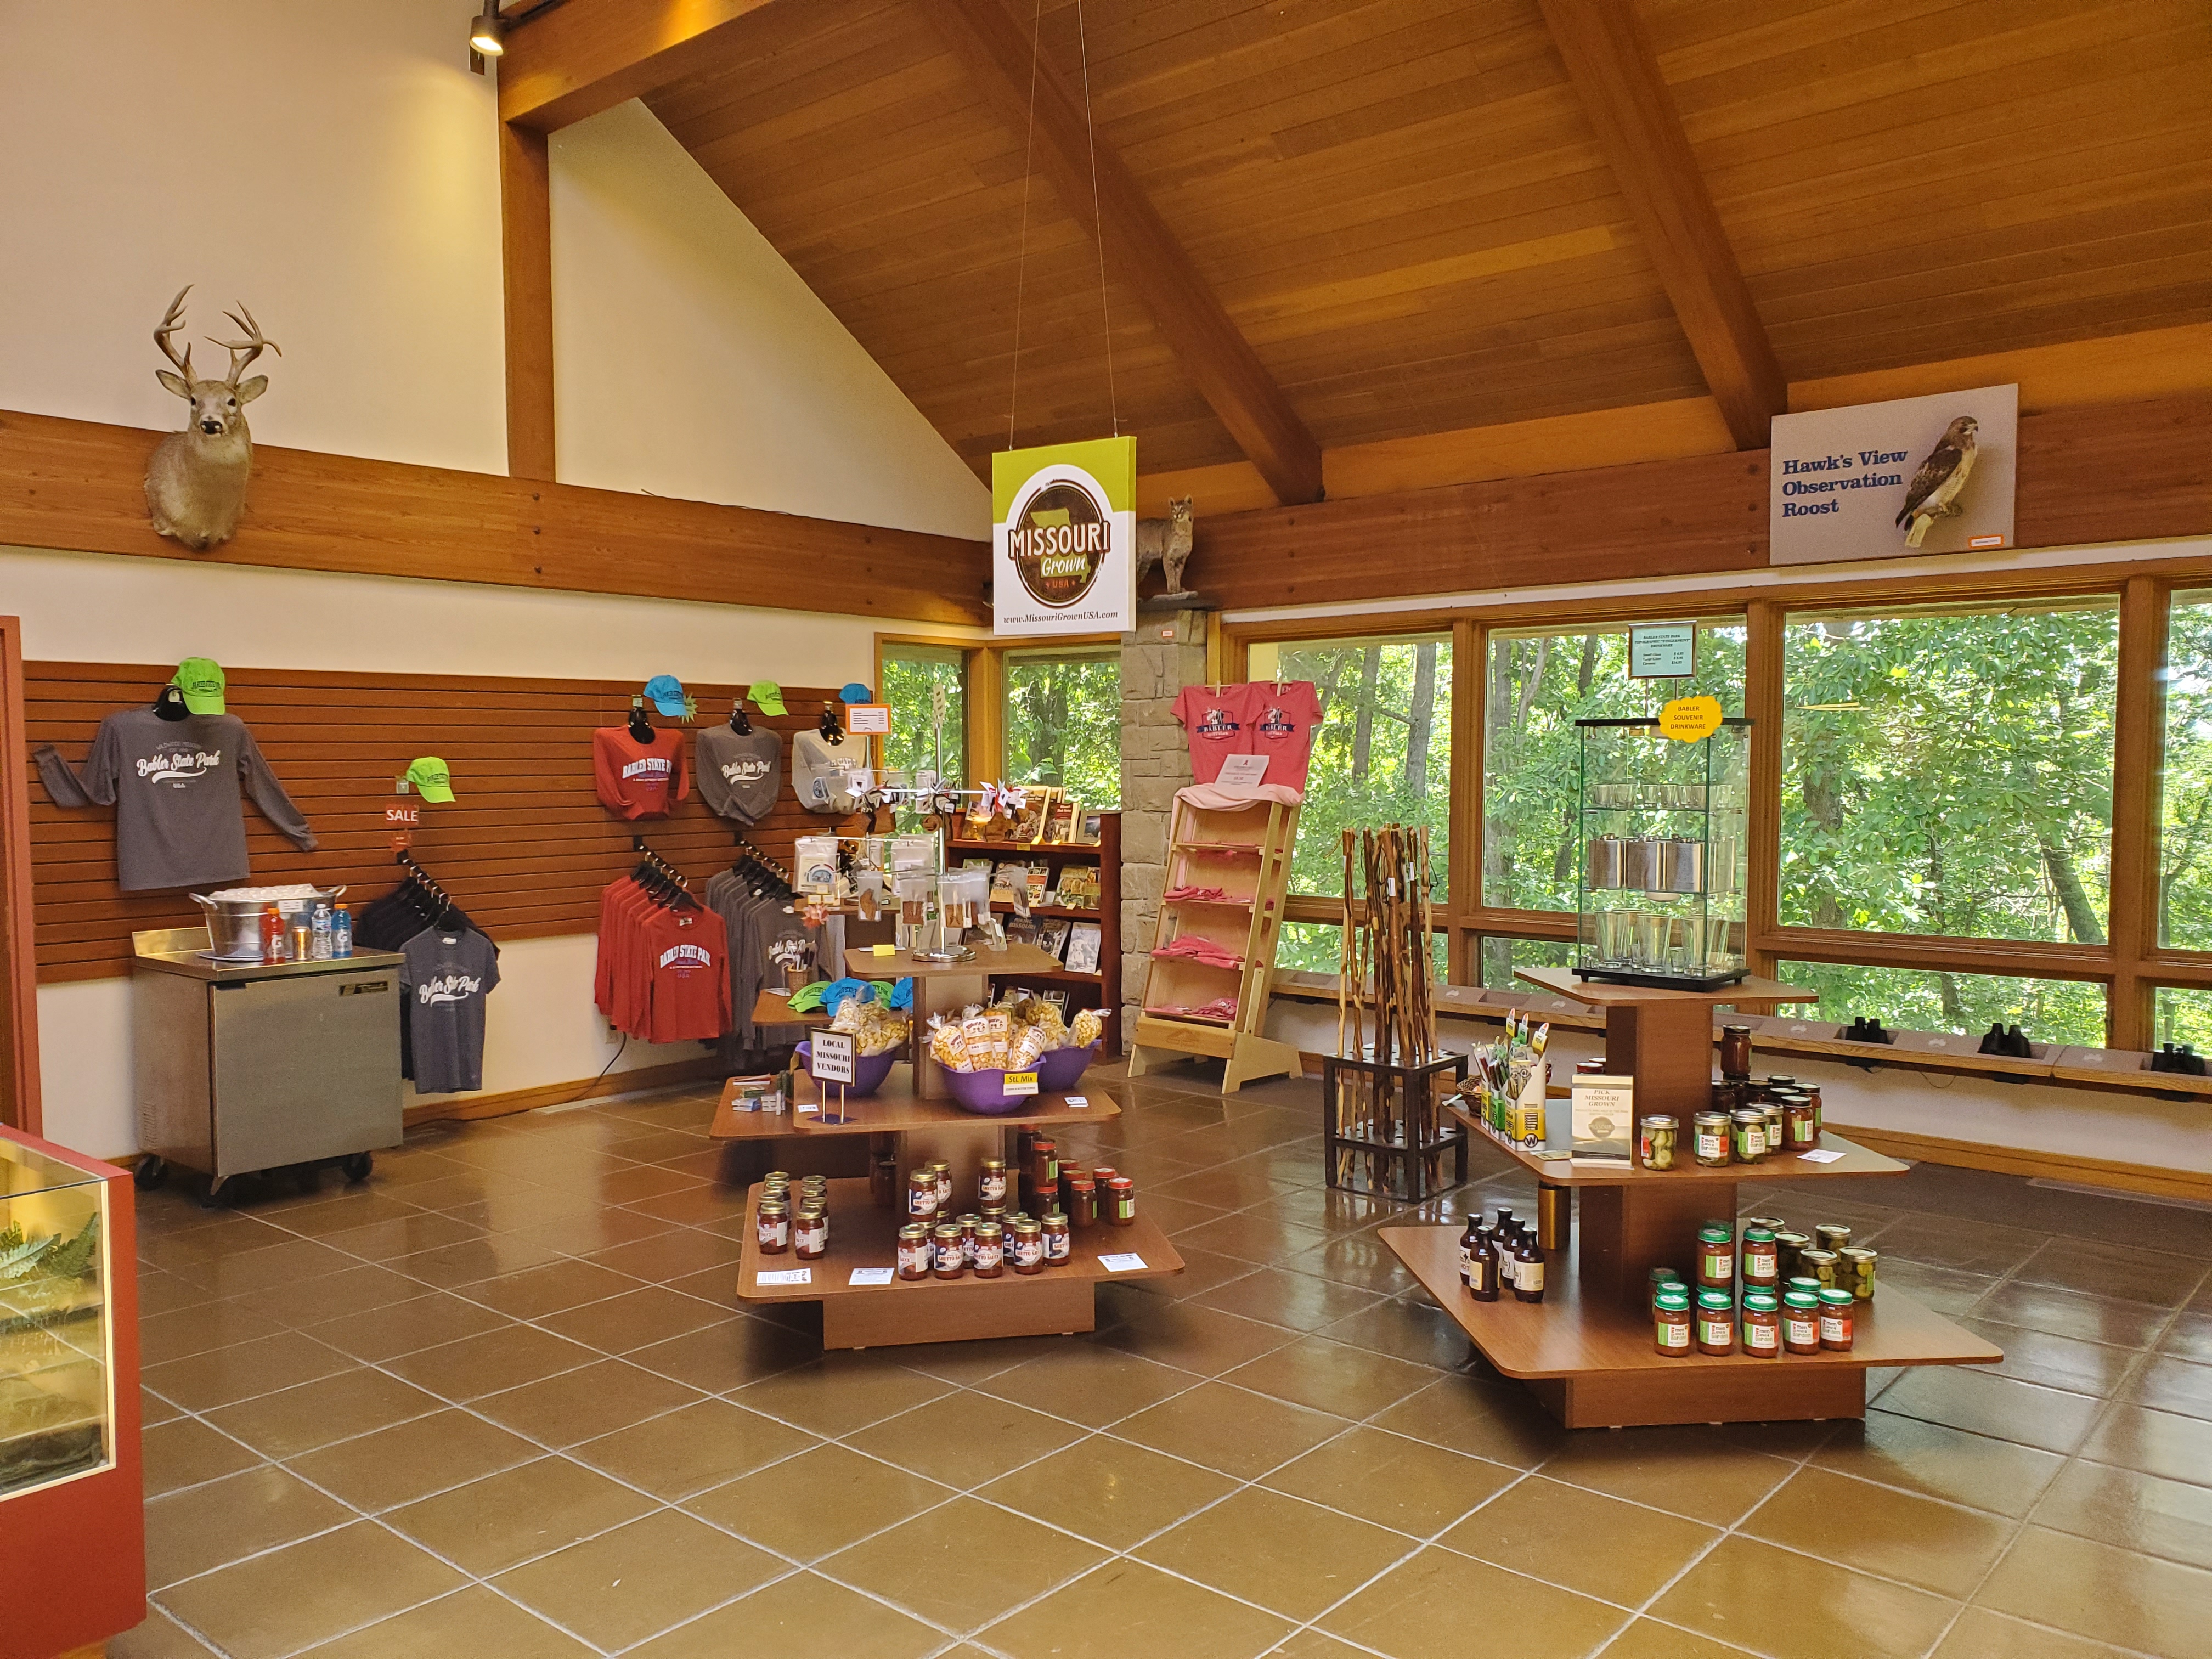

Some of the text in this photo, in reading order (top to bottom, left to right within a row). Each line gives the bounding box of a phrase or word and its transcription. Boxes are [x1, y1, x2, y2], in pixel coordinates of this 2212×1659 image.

[1782, 450, 1909, 475] Hawk's View
[1782, 473, 1903, 496] Observation
[1782, 499, 1839, 517] Roost
[1009, 521, 1110, 559] MISSOURI
[1042, 556, 1086, 577] Grown
[1052, 580, 1069, 589] USA
[1003, 611, 1118, 624] www.MissouriGrownUSA.com
[137, 750, 221, 777] Babler State Park
[647, 758, 665, 772] STATE
[386, 809, 419, 822] SALE
[679, 945, 697, 959] STATE
[823, 1039, 845, 1049] LOCAL
[816, 1051, 850, 1062] MISSOURI
[817, 1062, 850, 1074] VENDORS
[1525, 1136, 1536, 1146] W
